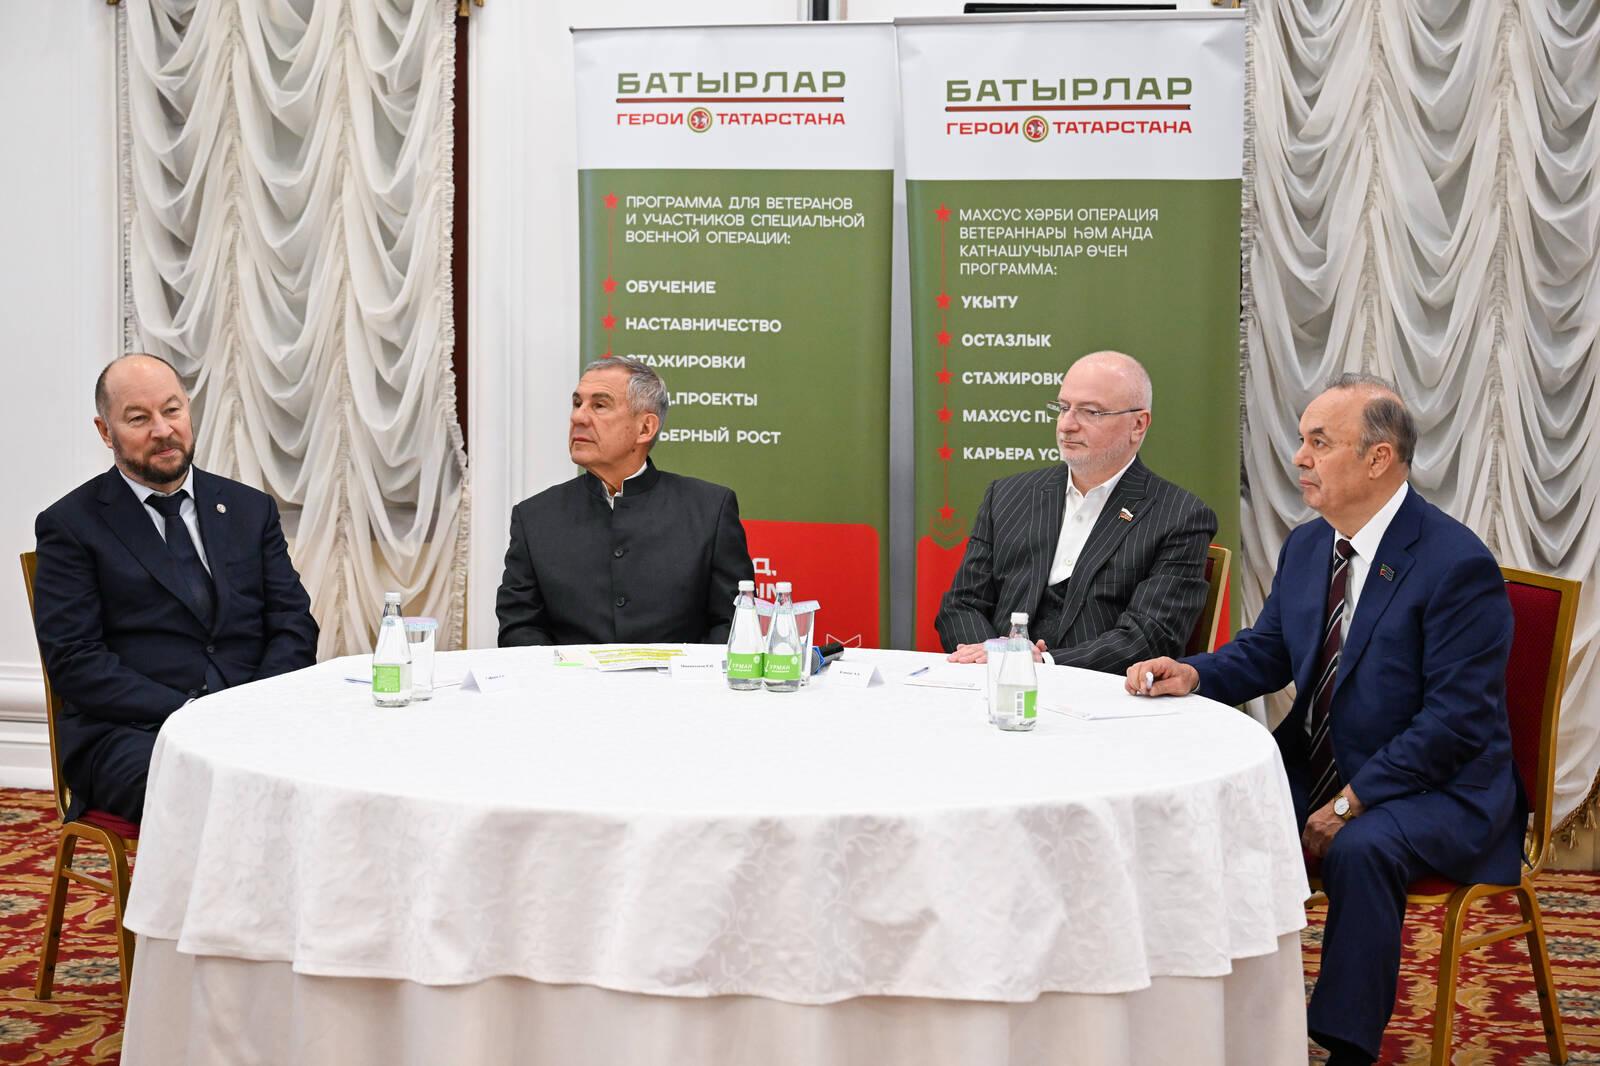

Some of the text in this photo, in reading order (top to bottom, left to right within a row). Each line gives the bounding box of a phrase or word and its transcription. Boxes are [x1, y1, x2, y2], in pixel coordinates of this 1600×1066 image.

[617, 71, 846, 94] БАТЫРЛАР
[946, 77, 1193, 102] БАТЫРЛАР
[616, 112, 846, 126] ГЕРОИ ТАТАРСТАНА
[946, 120, 1192, 135] ГЕРОИ ТАТАРСТАНА
[625, 195, 854, 211] ПРОГРАММА ДЛЯ ВЕТЕРАНОВ
[625, 212, 865, 228] И УЧАСТНИКОВ СПЕЦИАЛЬНОЙ
[959, 207, 1159, 223] МАХСУС ХӘРБИ ОПЕРАЦИЯ
[625, 228, 791, 245] ВОЕННОЙ ОПЕРАЦИИ:
[959, 226, 1067, 240] ВЕТЕРАННАРЫ
[1111, 226, 1154, 241] АНДА
[959, 244, 1084, 258] КАТНАШУЧЫЛАР
[959, 262, 1057, 276] ПРОГРАММА:
[625, 279, 717, 294] ОБУЧЕНИЕ
[961, 295, 1019, 309] УКЫТУ
[625, 316, 782, 333] НАСТАВНИЧЕСТВО
[961, 333, 1052, 347] ОСТАЗЛЫК
[961, 371, 1065, 386] СТАЖИРОВК
[962, 409, 1032, 423] МАХСУС
[658, 426, 782, 445] ЬЕРНЫЙ РОСТ
[963, 447, 1035, 461] КАРЬЕРА
